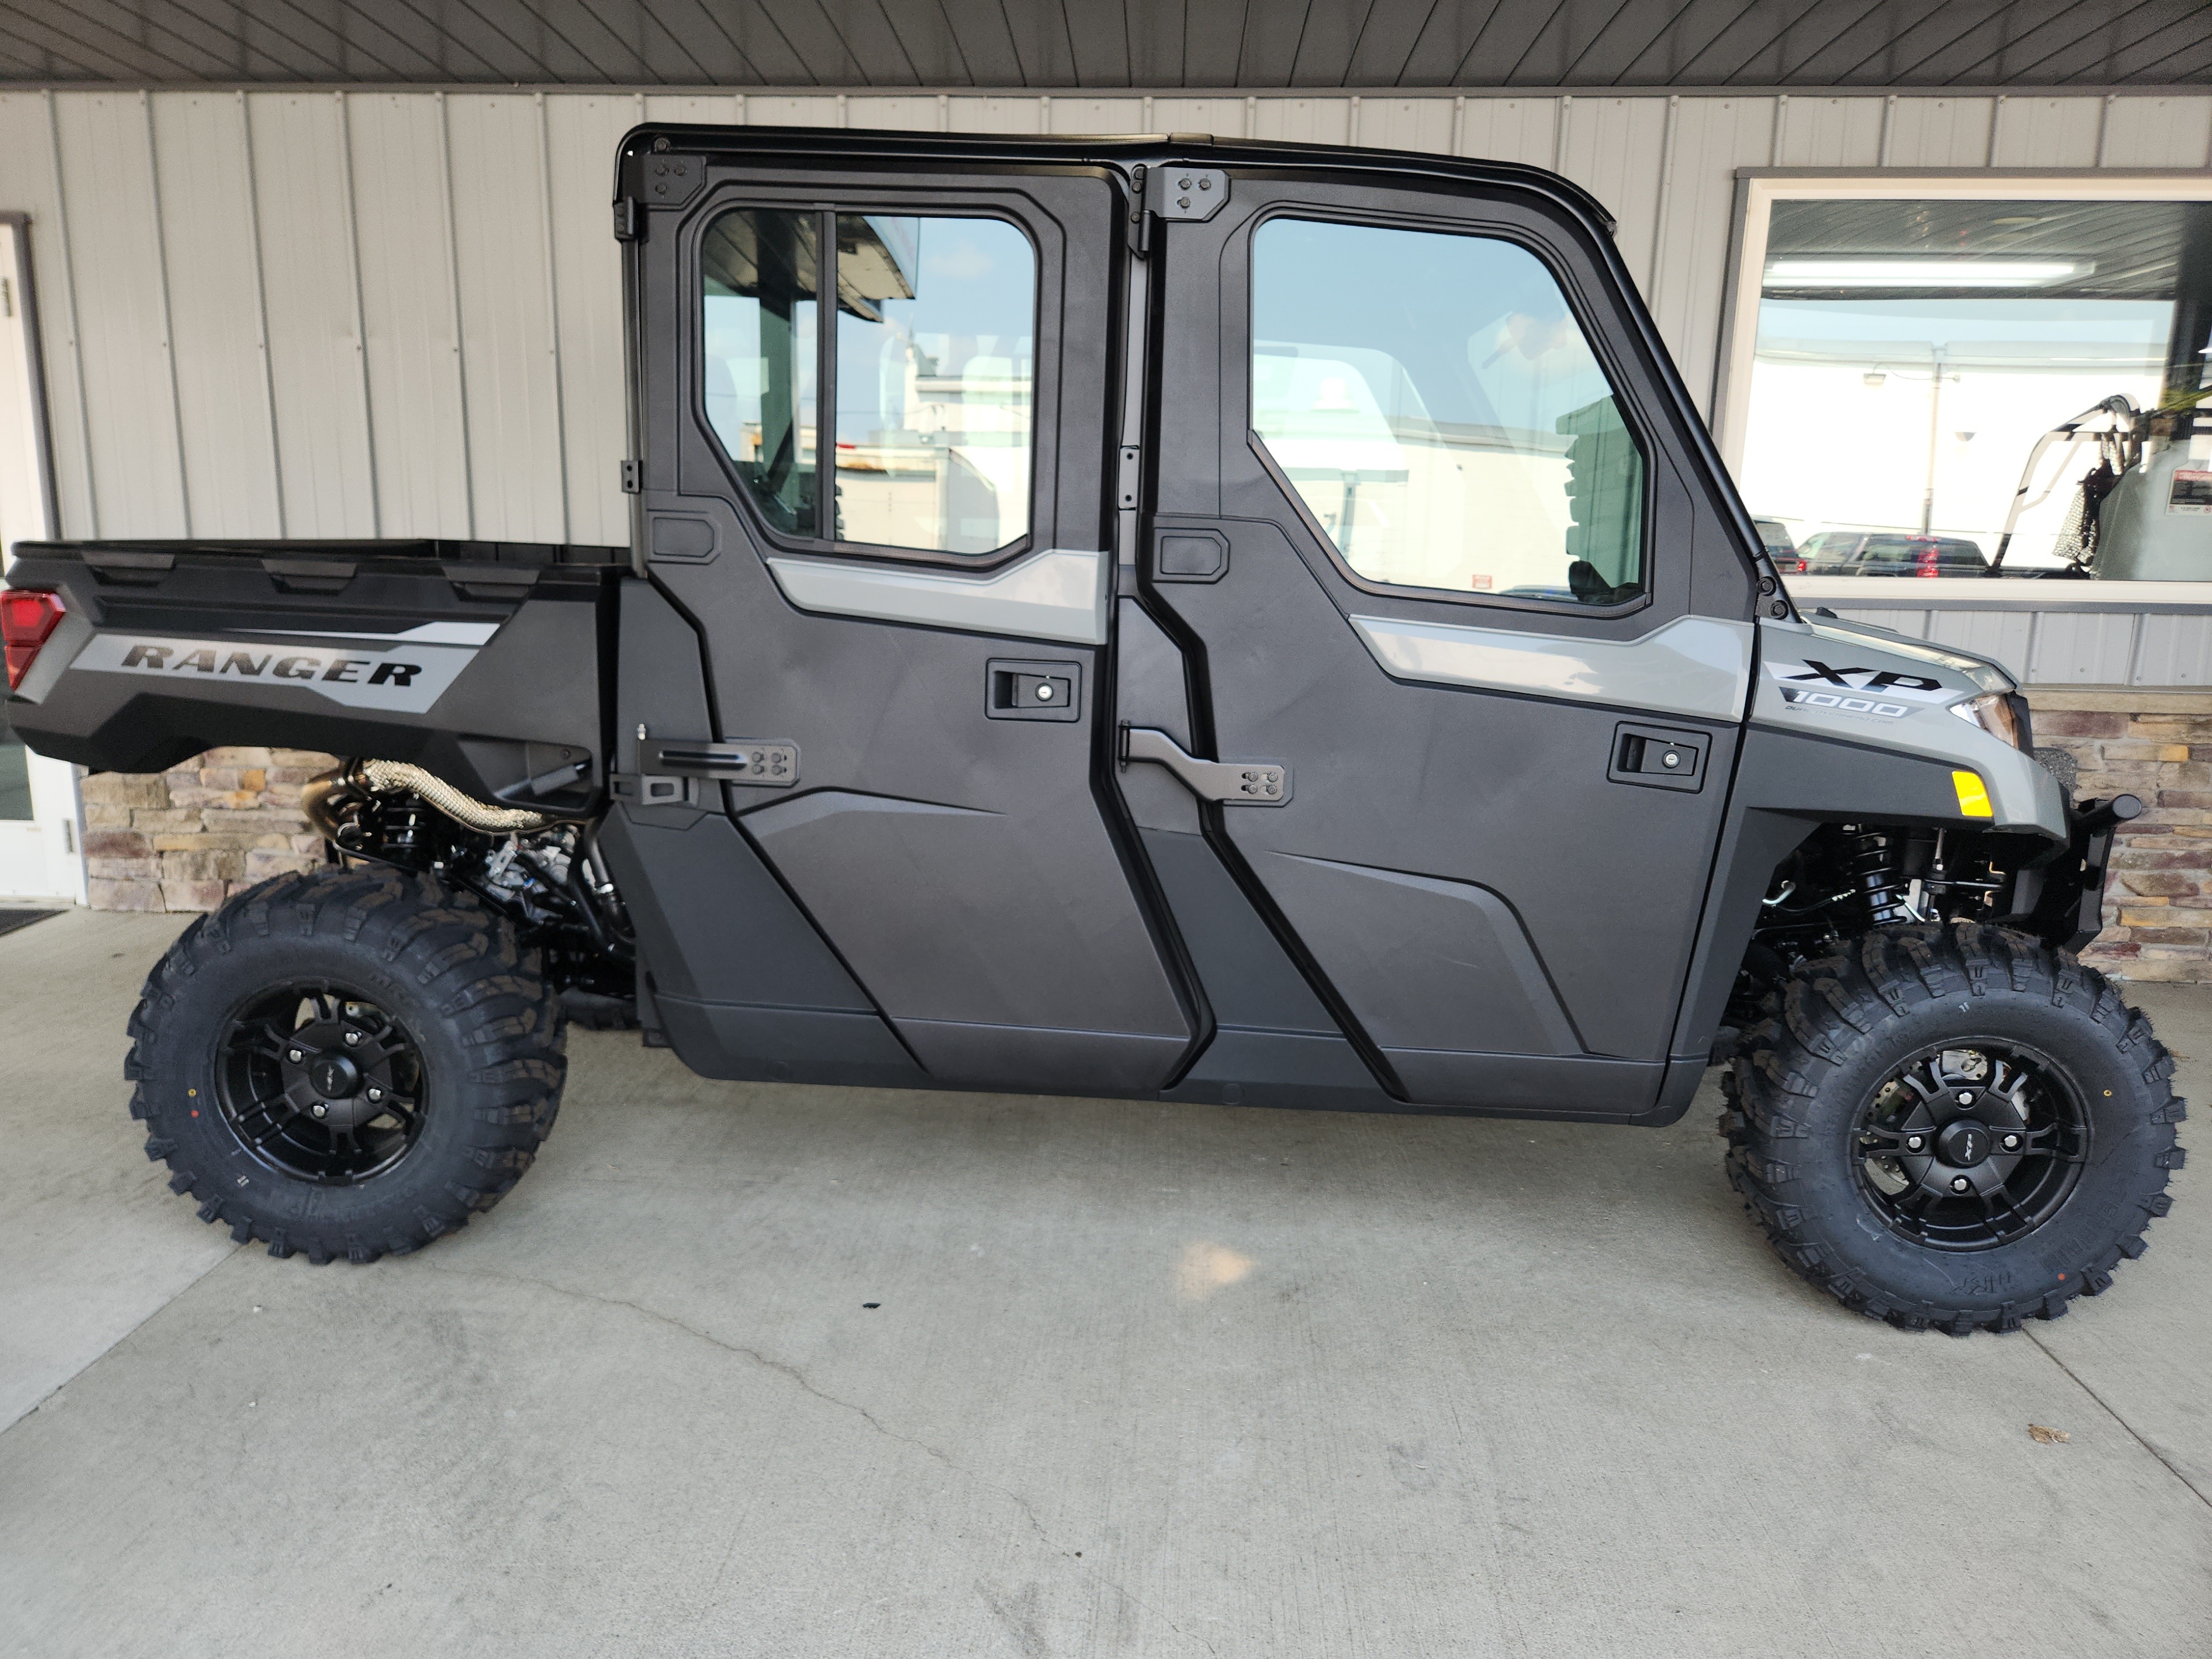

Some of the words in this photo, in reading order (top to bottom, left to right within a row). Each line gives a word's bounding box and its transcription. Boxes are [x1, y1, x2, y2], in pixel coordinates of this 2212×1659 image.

[121, 644, 422, 687] RANGER
[1779, 659, 1943, 693] XP
[1793, 690, 1908, 718] 1000
